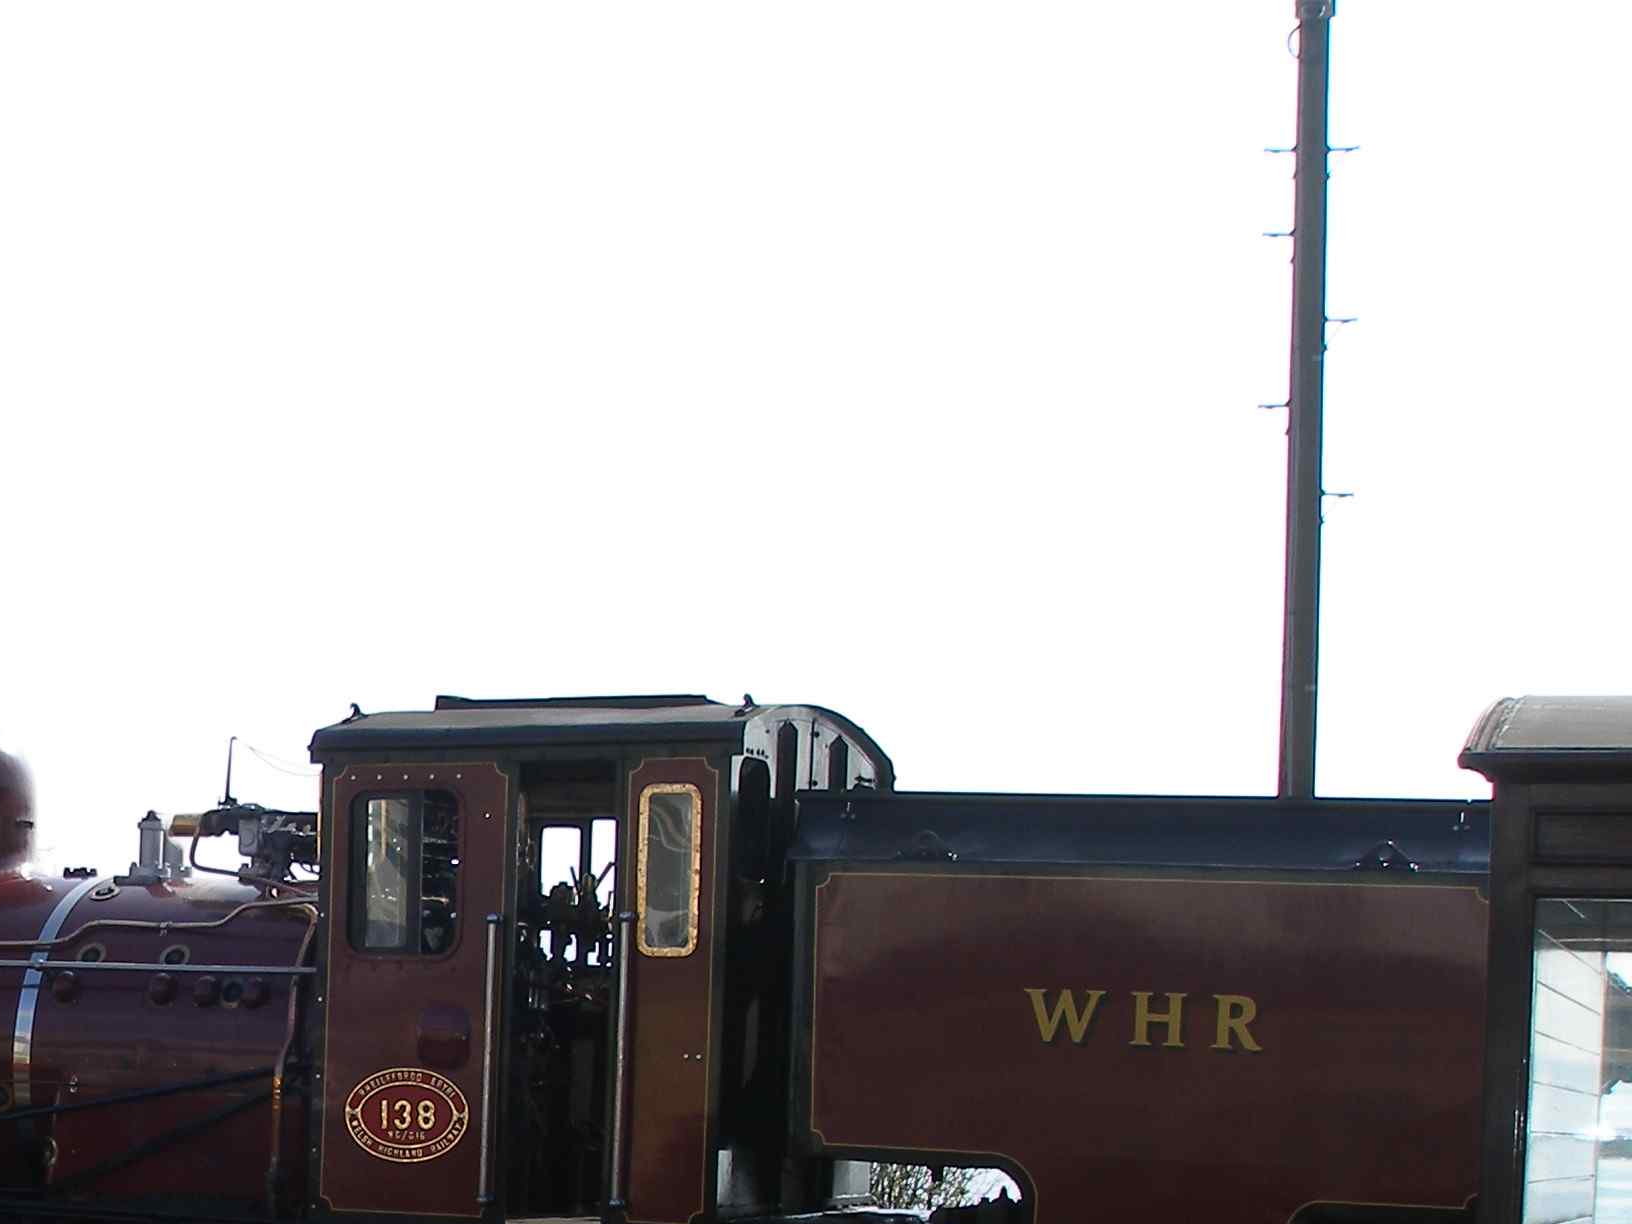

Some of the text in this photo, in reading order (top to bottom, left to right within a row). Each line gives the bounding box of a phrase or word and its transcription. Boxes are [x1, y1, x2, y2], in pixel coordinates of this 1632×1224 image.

[381, 1099, 435, 1130] 138
[351, 1120, 462, 1158] WELSH HIGHLAND RAILWAY
